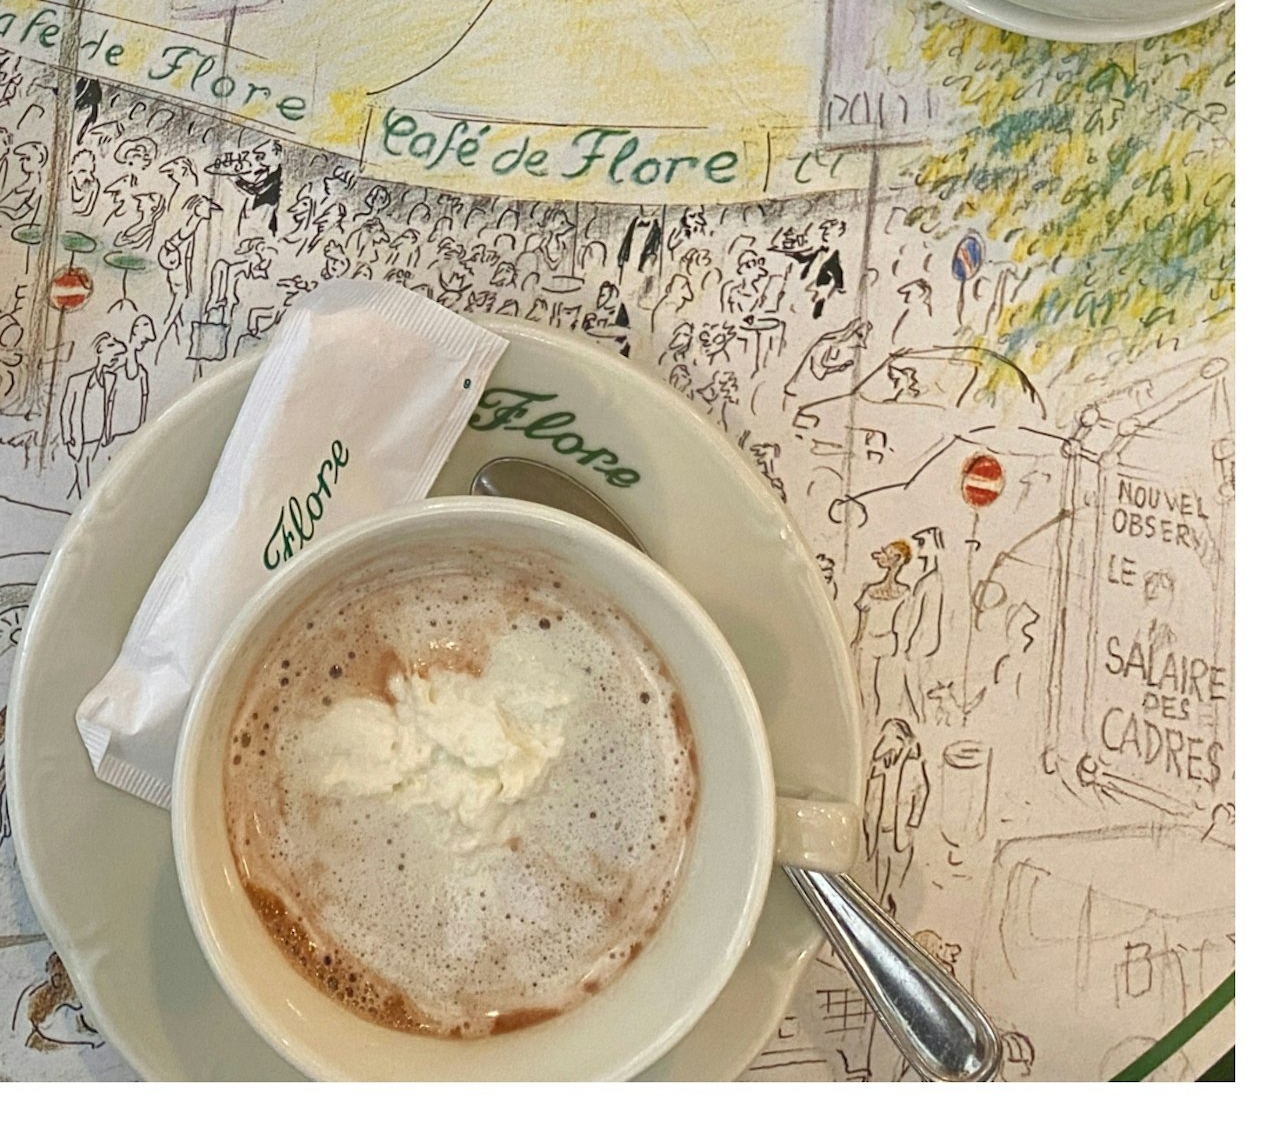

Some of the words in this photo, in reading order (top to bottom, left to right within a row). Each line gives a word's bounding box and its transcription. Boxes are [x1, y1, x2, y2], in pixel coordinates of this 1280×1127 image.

[148, 45, 307, 121] Flore
[382, 107, 491, 170] Café
[490, 136, 549, 175] de
[560, 128, 739, 184] Flore
[469, 388, 641, 488] Flore
[263, 439, 350, 570] Flore
[1118, 479, 1209, 520] NOUVEL
[1108, 554, 1136, 586] LE
[1105, 635, 1227, 702] SALAIRE
[1101, 707, 1224, 785] CADRES
